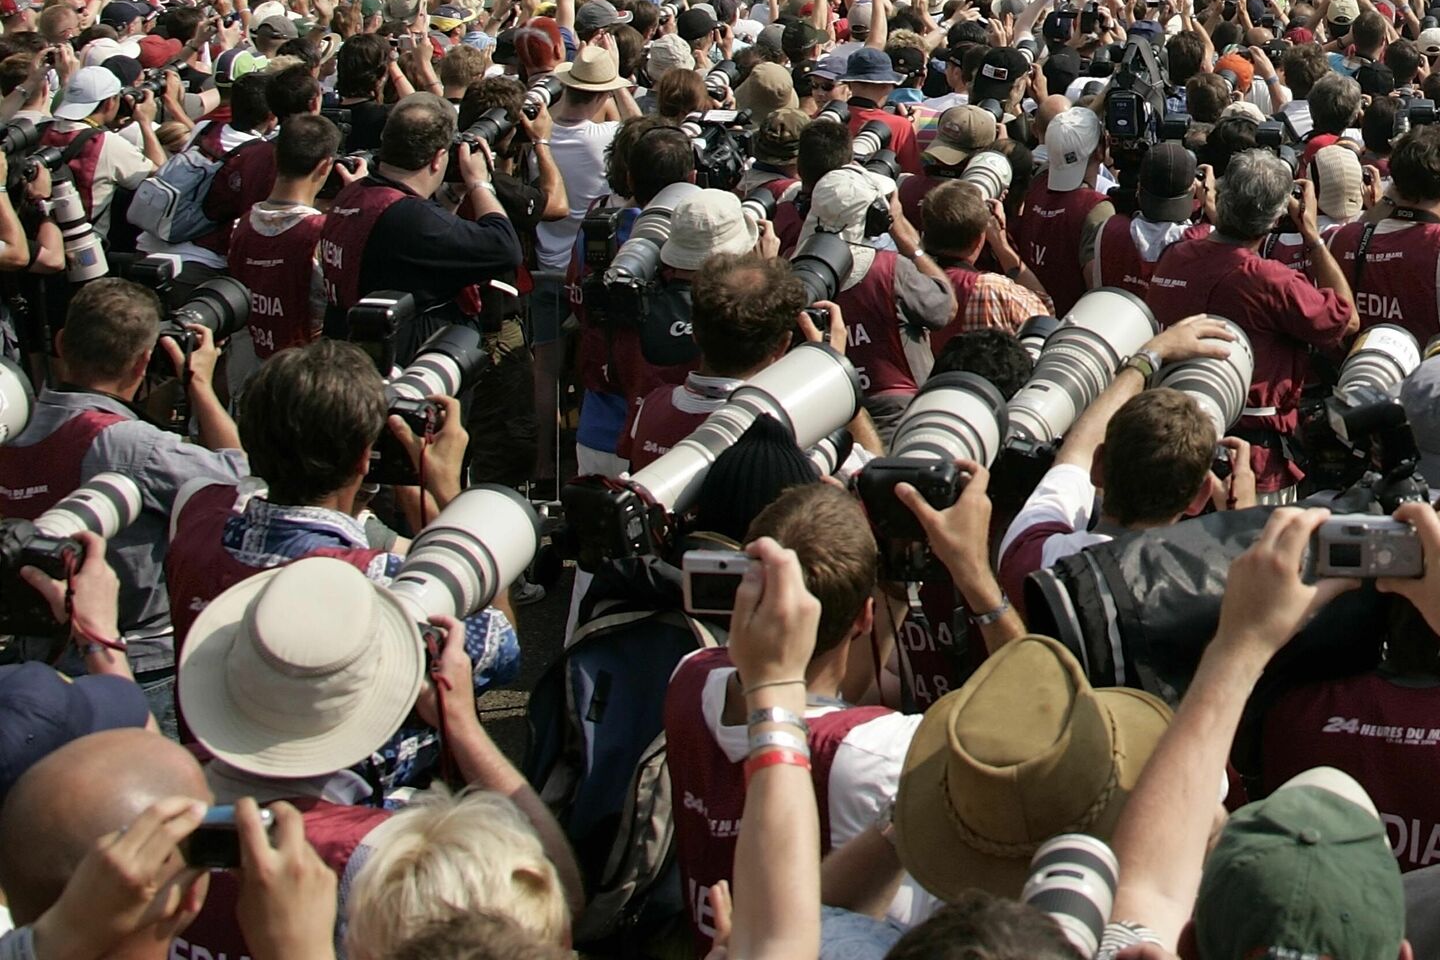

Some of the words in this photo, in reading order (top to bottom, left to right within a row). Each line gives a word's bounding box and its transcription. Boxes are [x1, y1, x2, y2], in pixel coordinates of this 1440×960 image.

[251, 293, 284, 317] EDIA
[1357, 292, 1403, 319] EDIA
[1322, 716, 1360, 734] 24
[1360, 724, 1403, 738] HEURES
[1406, 727, 1425, 739] DU
